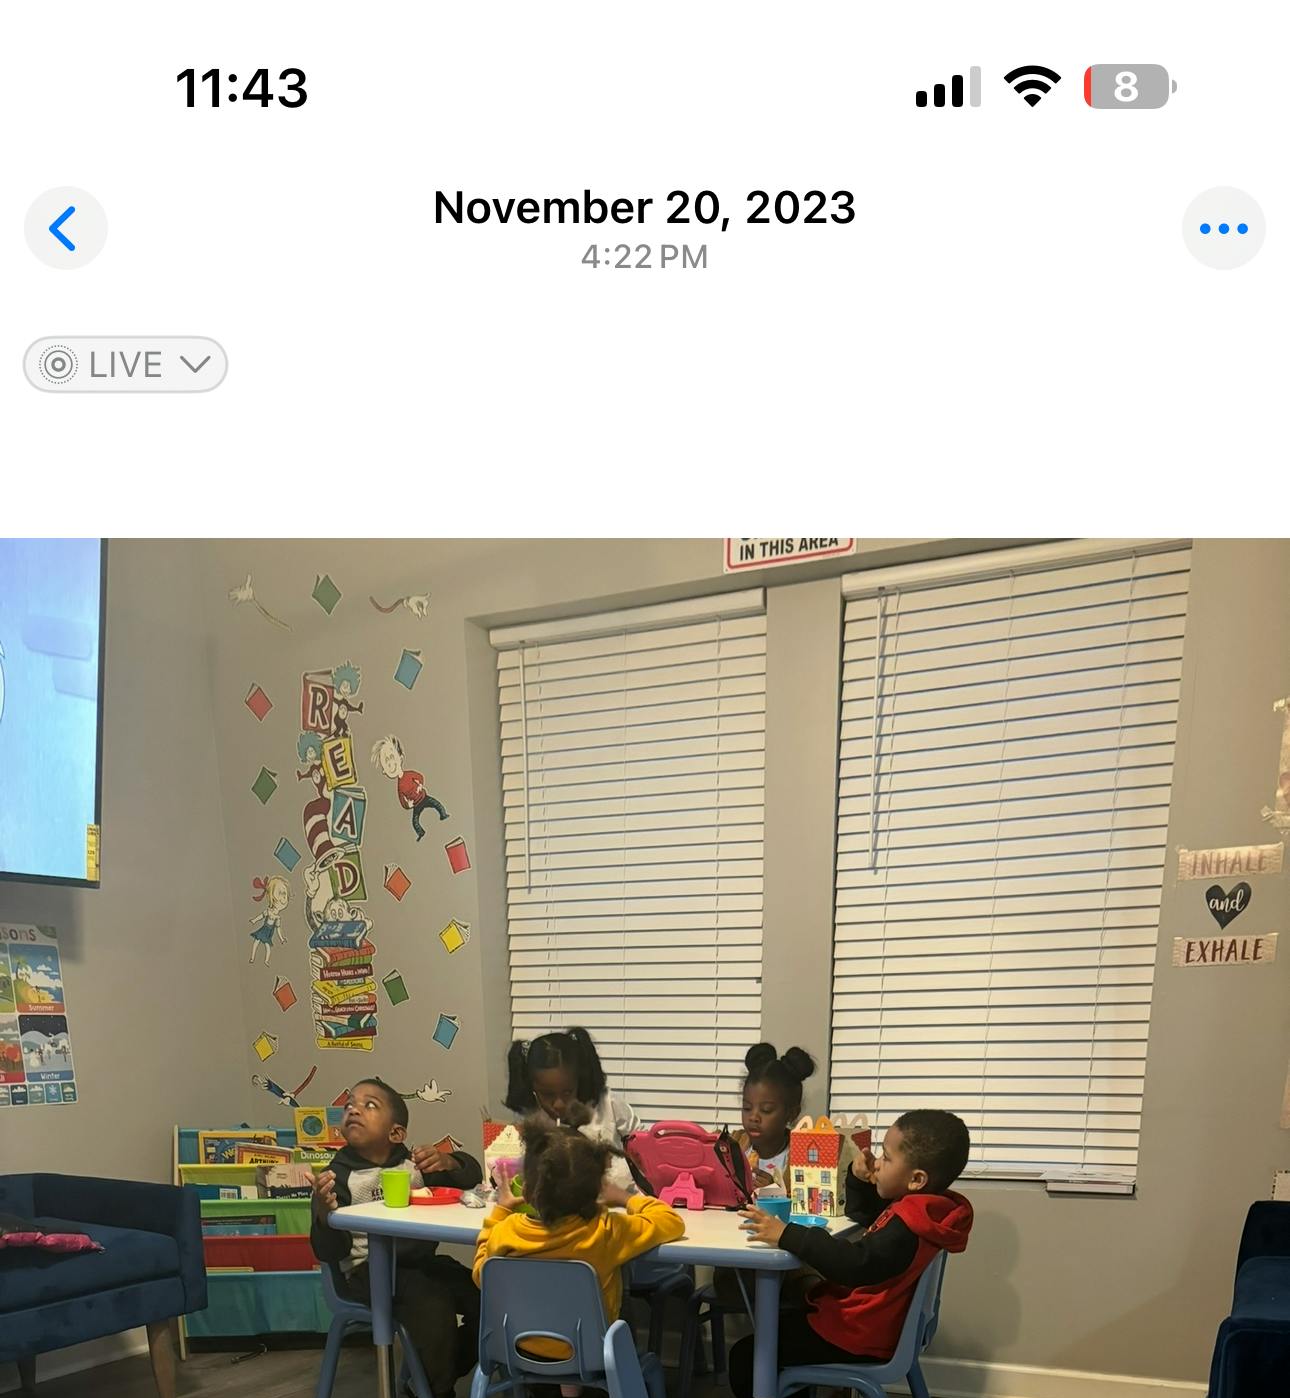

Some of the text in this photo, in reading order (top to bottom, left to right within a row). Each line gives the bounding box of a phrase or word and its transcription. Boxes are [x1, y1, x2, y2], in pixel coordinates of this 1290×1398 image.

[740, 538, 839, 560] IN THIS AREA
[1194, 851, 1267, 875] INHALE
[1210, 889, 1244, 912] and
[1186, 938, 1264, 963] EXHALE
[28, 1004, 55, 1012] Summer
[40, 1072, 60, 1080] Winter
